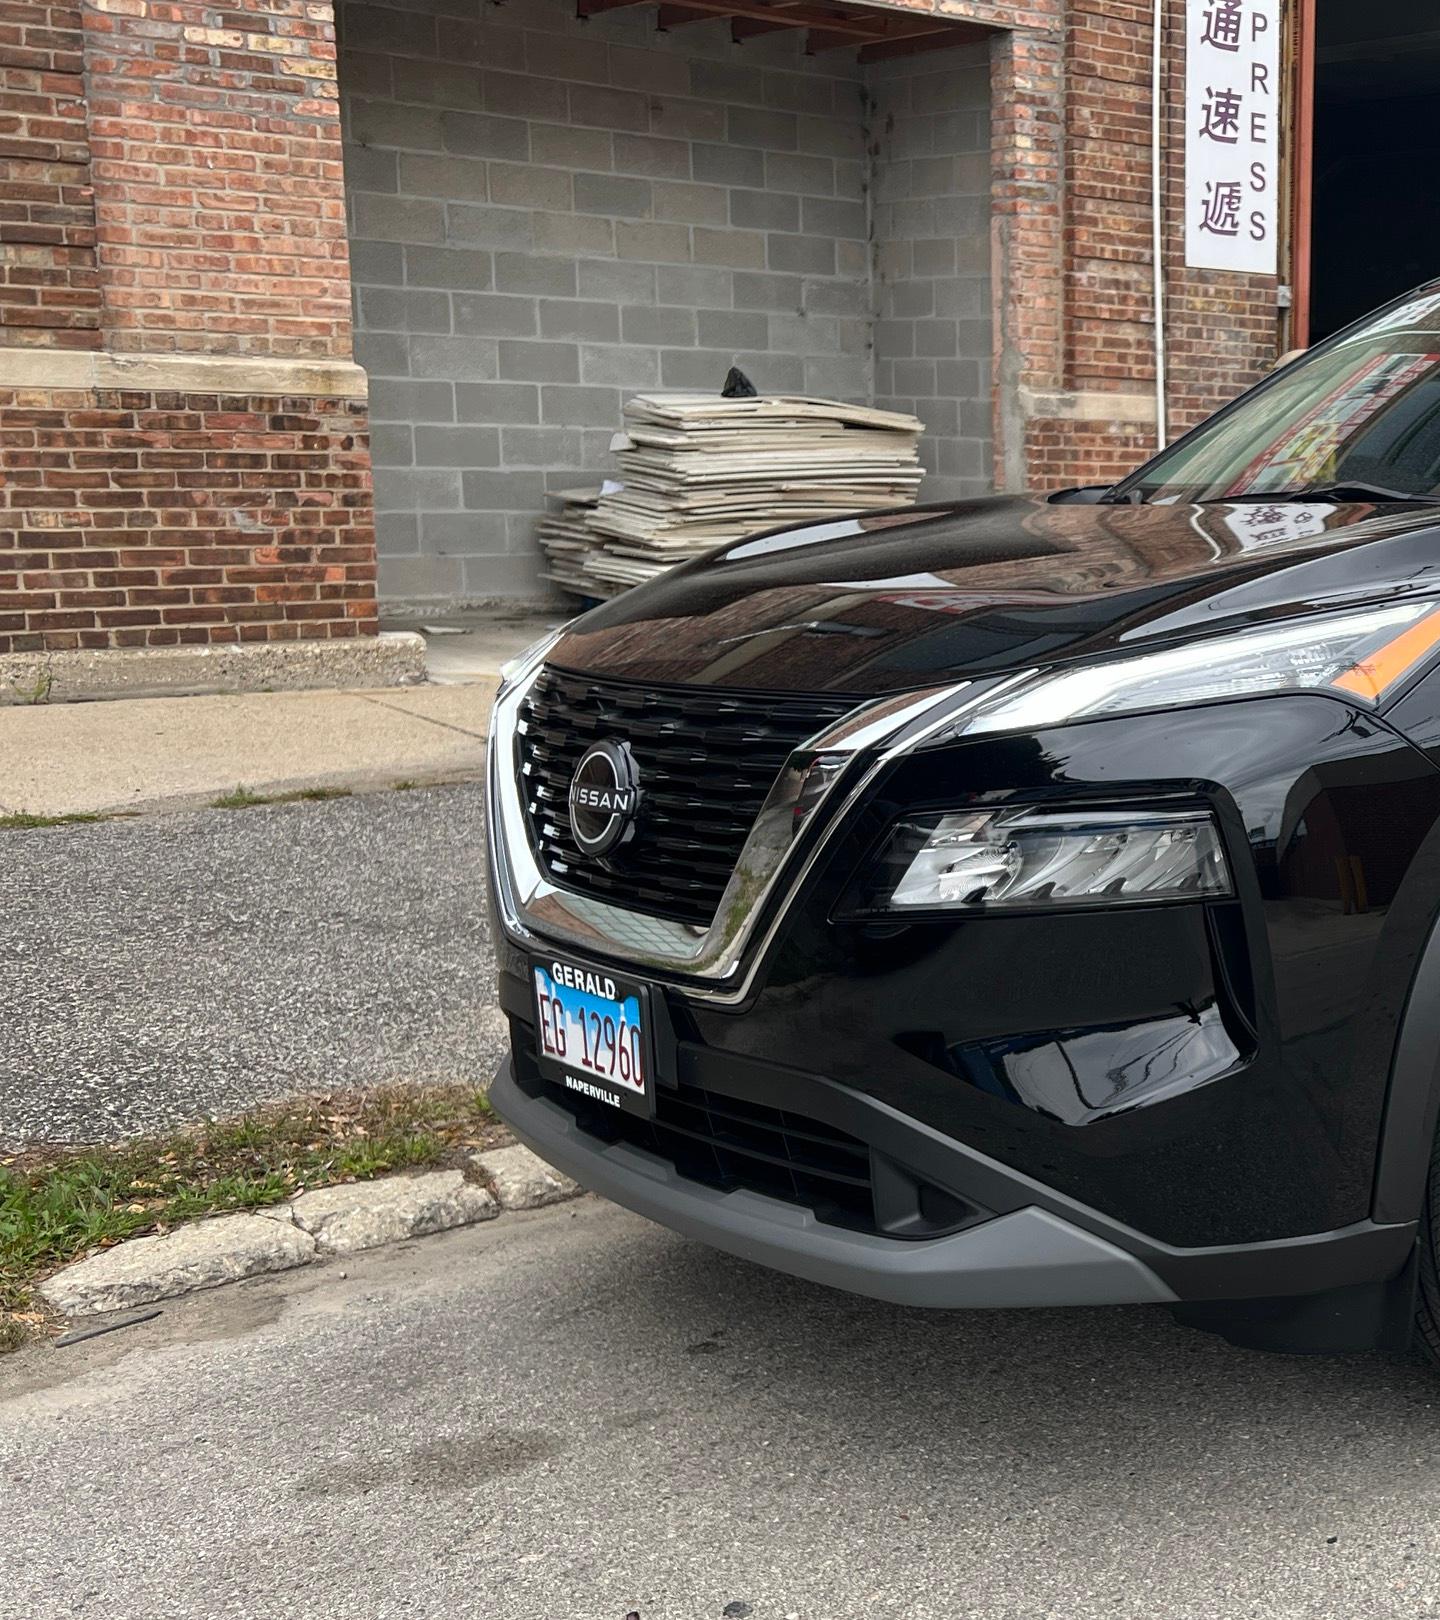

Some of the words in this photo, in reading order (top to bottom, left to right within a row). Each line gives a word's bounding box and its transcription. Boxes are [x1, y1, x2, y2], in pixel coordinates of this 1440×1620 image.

[1199, 0, 1243, 236] 通速遞
[1250, 12, 1269, 241] PRESS
[571, 785, 629, 811] NISSAN
[552, 962, 616, 1000] GERALD
[540, 994, 567, 1058] EG
[578, 1007, 645, 1088] 12960
[565, 1075, 621, 1109] NAPERVILLE
